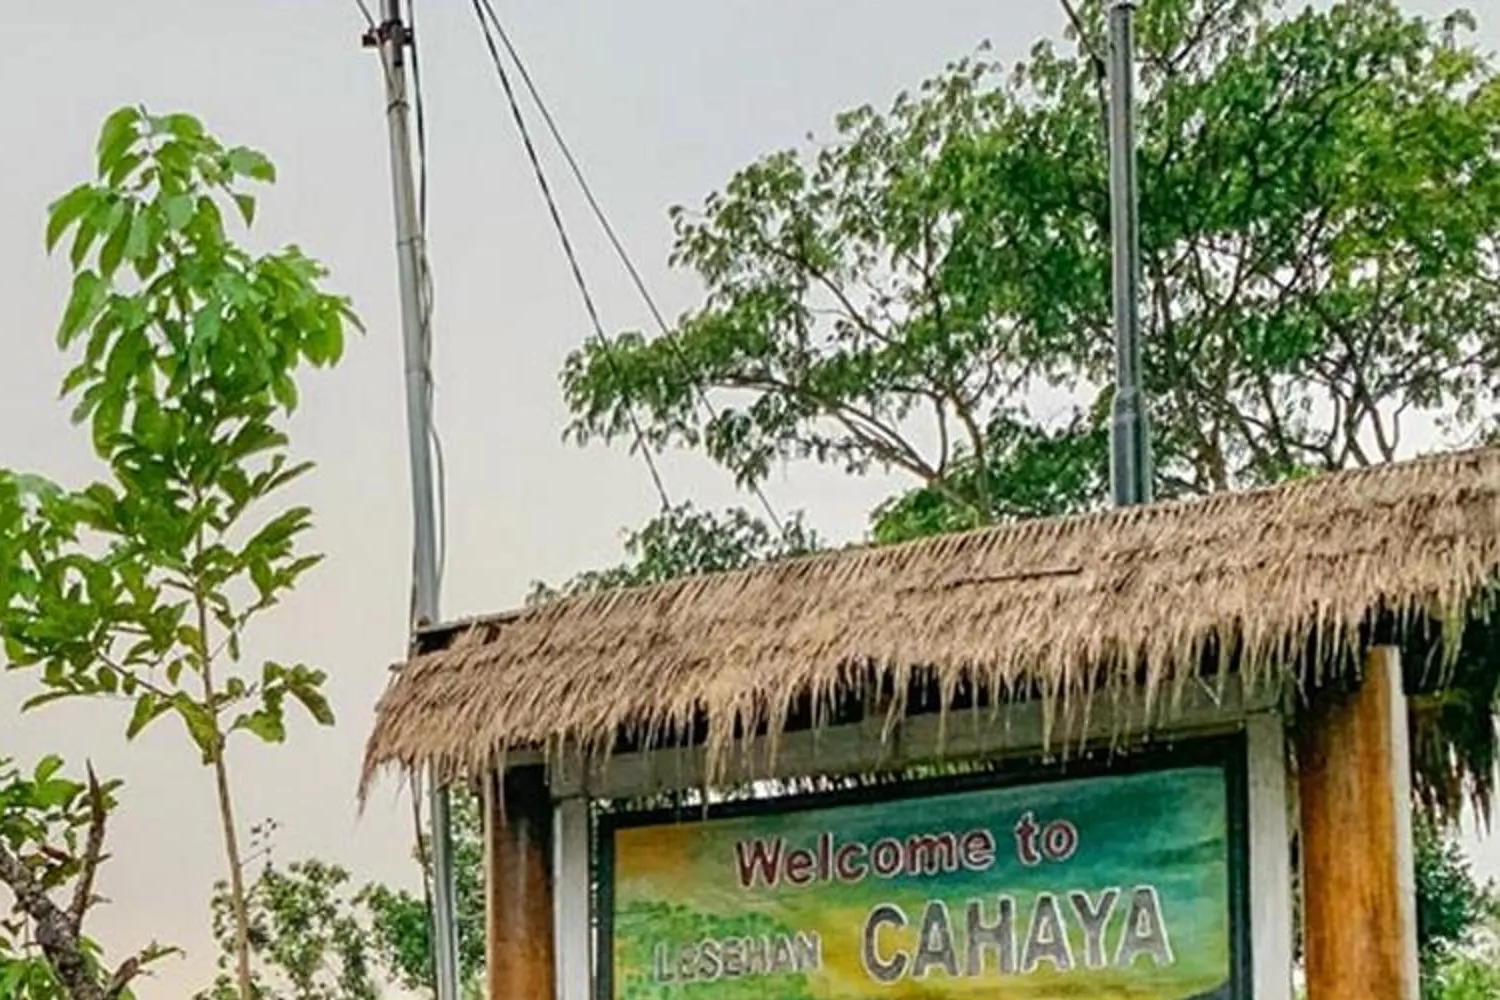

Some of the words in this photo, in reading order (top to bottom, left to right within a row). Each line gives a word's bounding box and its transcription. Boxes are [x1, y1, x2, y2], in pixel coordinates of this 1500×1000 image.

[734, 829, 998, 888] Welcome
[1014, 811, 1078, 865] to
[861, 885, 1174, 985] CAHAYA
